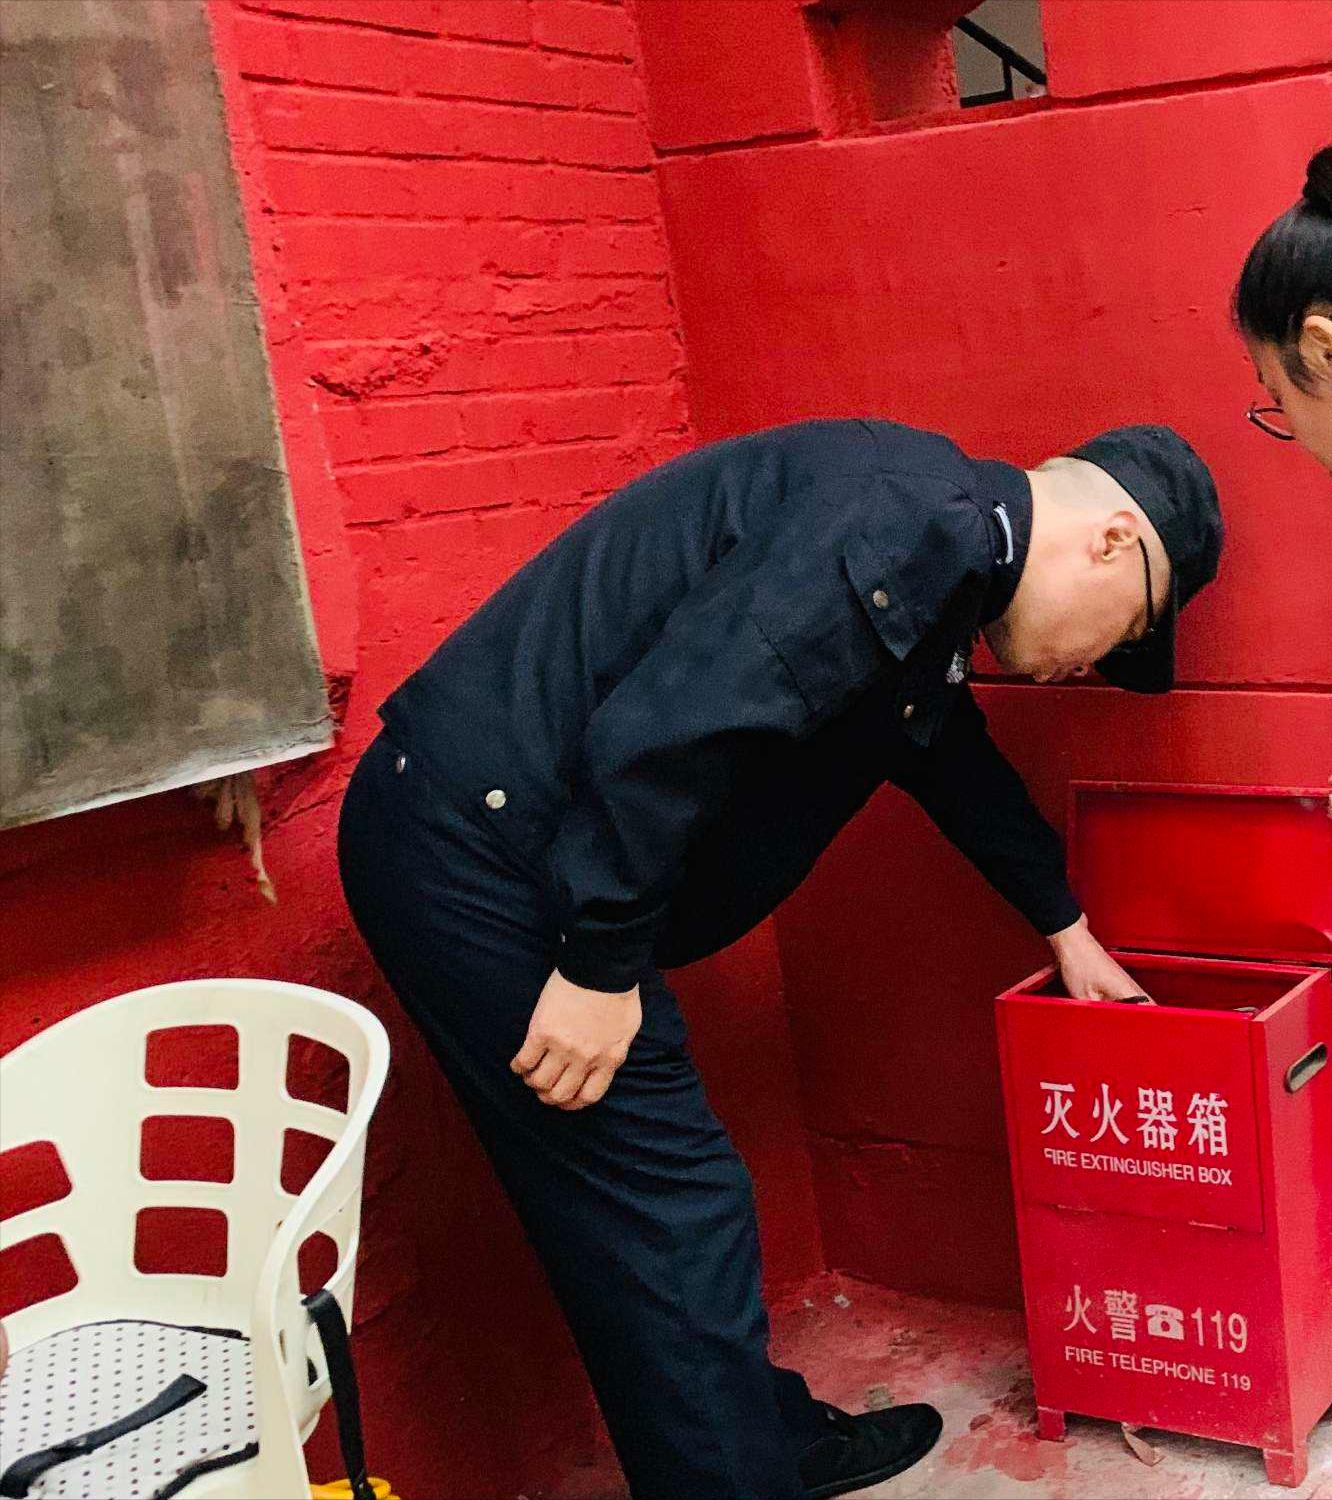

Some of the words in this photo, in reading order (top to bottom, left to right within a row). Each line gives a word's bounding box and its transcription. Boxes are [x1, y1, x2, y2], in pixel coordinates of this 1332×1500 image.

[1039, 1081, 1229, 1157] 灭火器箱
[1044, 1147, 1078, 1167] FIRE
[1080, 1152, 1195, 1182] EXTINGUISHER
[1197, 1166, 1232, 1186] BOX
[1063, 1284, 1139, 1343] 火警
[1191, 1306, 1248, 1354] 119
[1064, 1345, 1105, 1367] FIRE
[1107, 1351, 1216, 1386] TELEPHONE
[1221, 1372, 1252, 1392] 119
